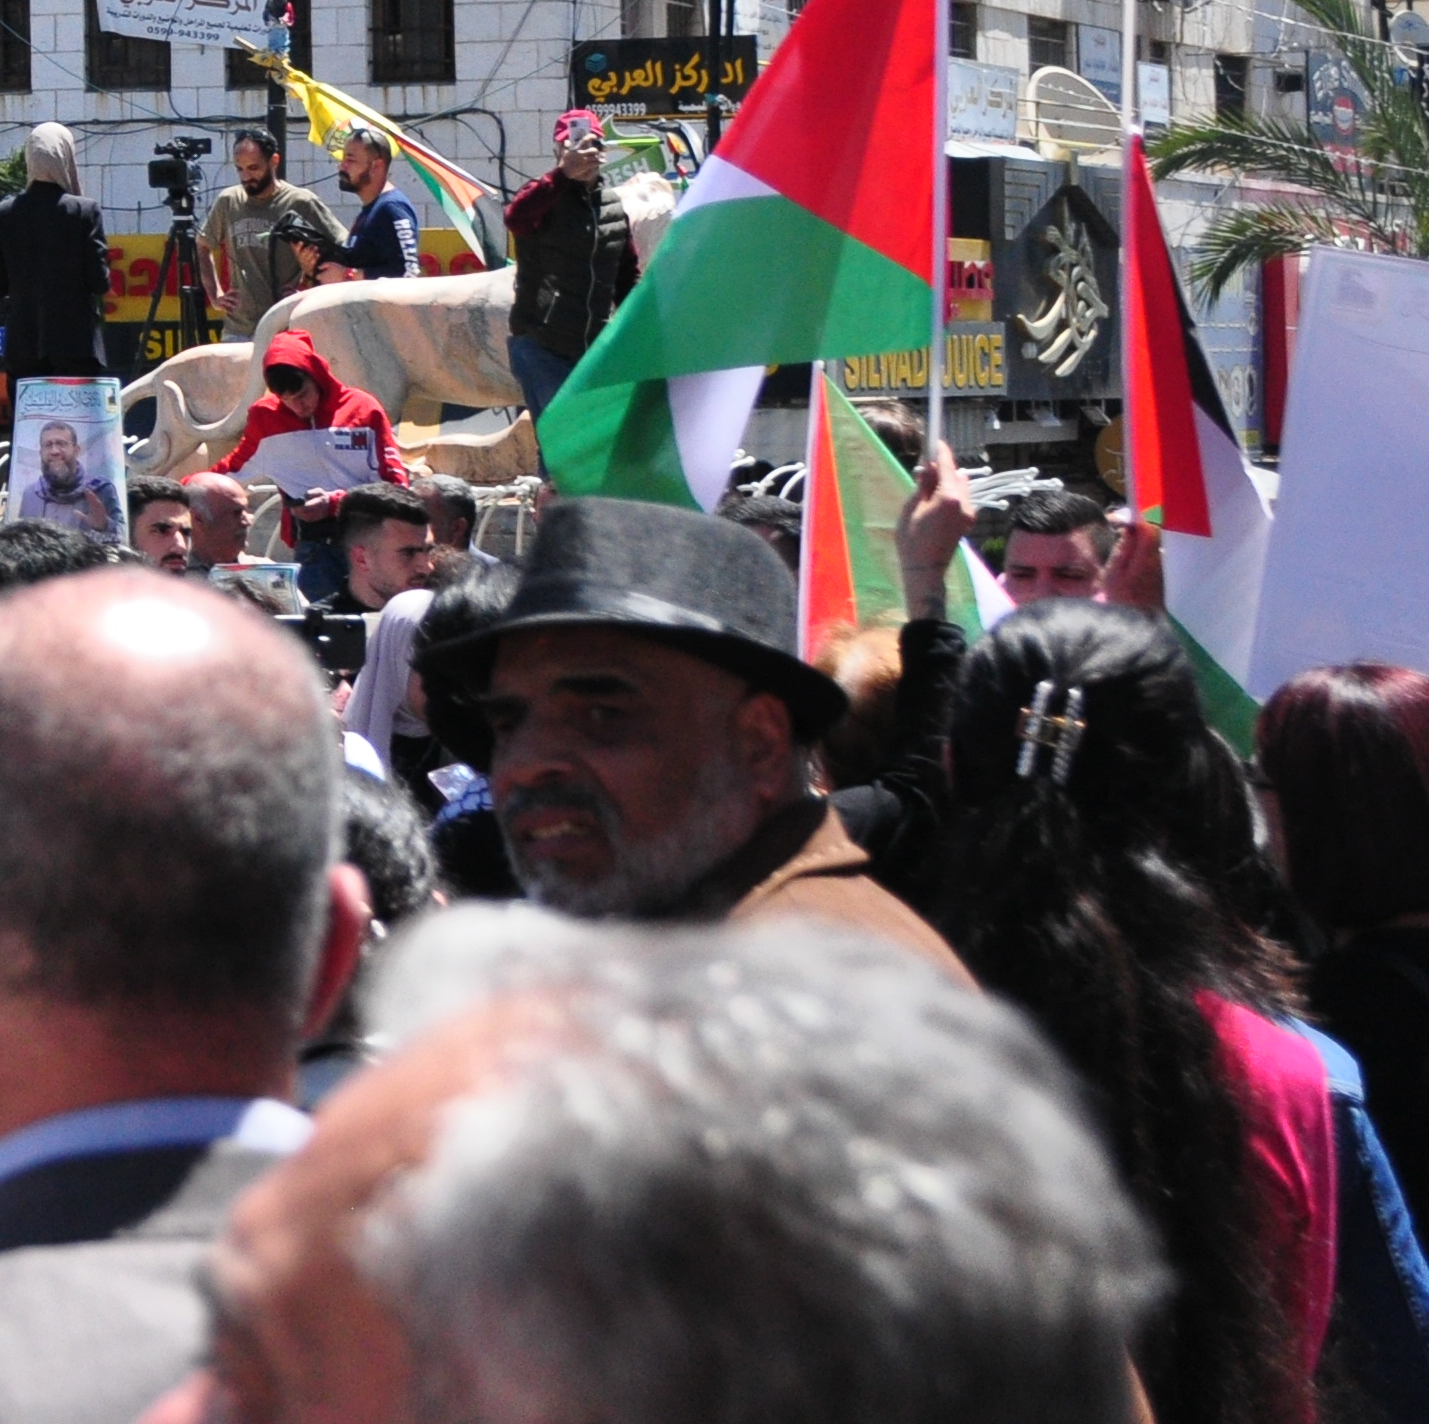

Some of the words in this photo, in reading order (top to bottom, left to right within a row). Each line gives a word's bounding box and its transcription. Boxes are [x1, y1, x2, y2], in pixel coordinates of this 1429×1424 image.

[147, 26, 219, 41] 0599-943399
[588, 60, 663, 102] العربي
[669, 52, 746, 94] الركز
[845, 347, 930, 390] SILWAD
[942, 334, 1003, 389] JUICE
